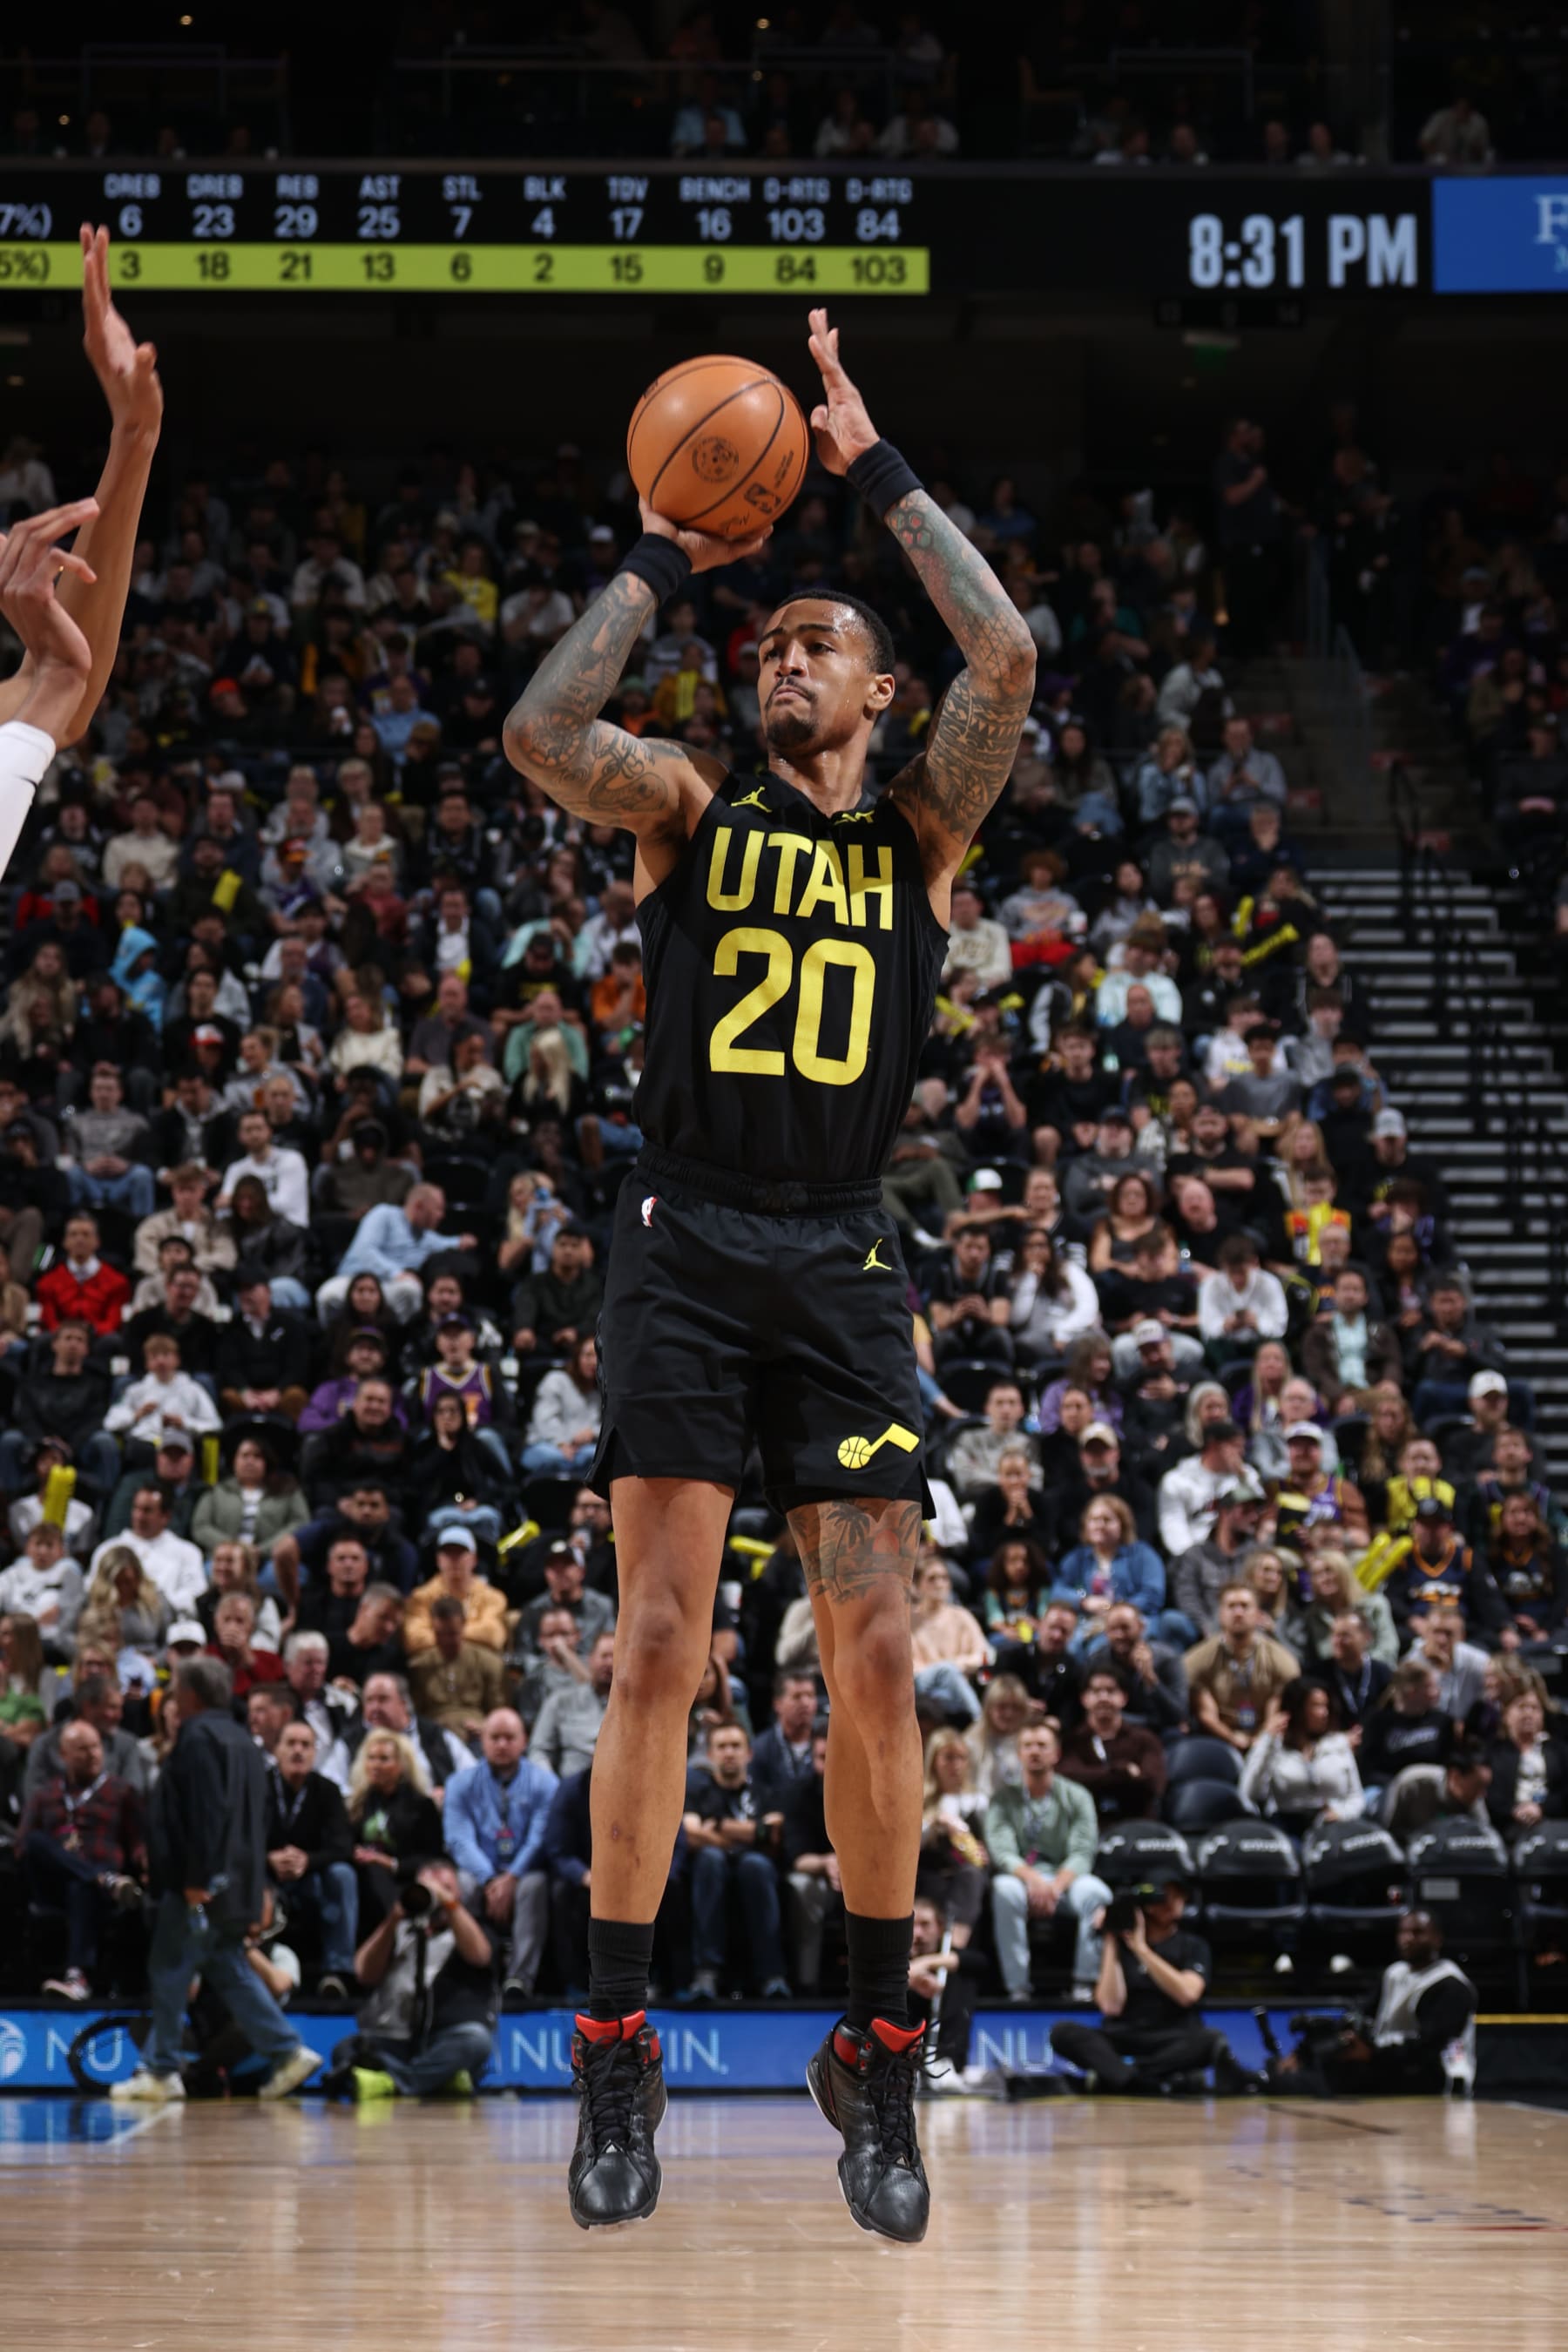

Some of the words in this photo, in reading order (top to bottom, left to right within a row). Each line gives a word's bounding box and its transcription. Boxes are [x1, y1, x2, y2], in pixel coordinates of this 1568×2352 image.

[276, 174, 319, 199] REB
[359, 175, 400, 200] AST
[443, 175, 481, 200] STL
[524, 176, 565, 200] BLK
[679, 177, 751, 202] BENCH
[119, 205, 143, 236] 6
[193, 205, 235, 237] 23
[275, 206, 318, 238] 29
[358, 206, 400, 238] 25
[452, 206, 472, 237] 7
[531, 207, 555, 238] 4
[611, 207, 644, 239] 17
[697, 208, 732, 240] 16
[767, 208, 826, 240] 103
[856, 209, 900, 241] 84
[1189, 213, 1305, 288] 8:31
[1328, 213, 1418, 288] PM
[119, 250, 142, 280] 3
[197, 251, 231, 281] 18
[280, 251, 312, 281] 21
[362, 251, 395, 282] 13
[449, 252, 472, 282] 6
[533, 253, 554, 283] 2
[610, 253, 644, 284] 15
[703, 253, 726, 284] 9
[774, 254, 817, 285] 84
[851, 254, 908, 286] 103
[706, 827, 893, 930] UTAH
[710, 927, 875, 1086] 20
